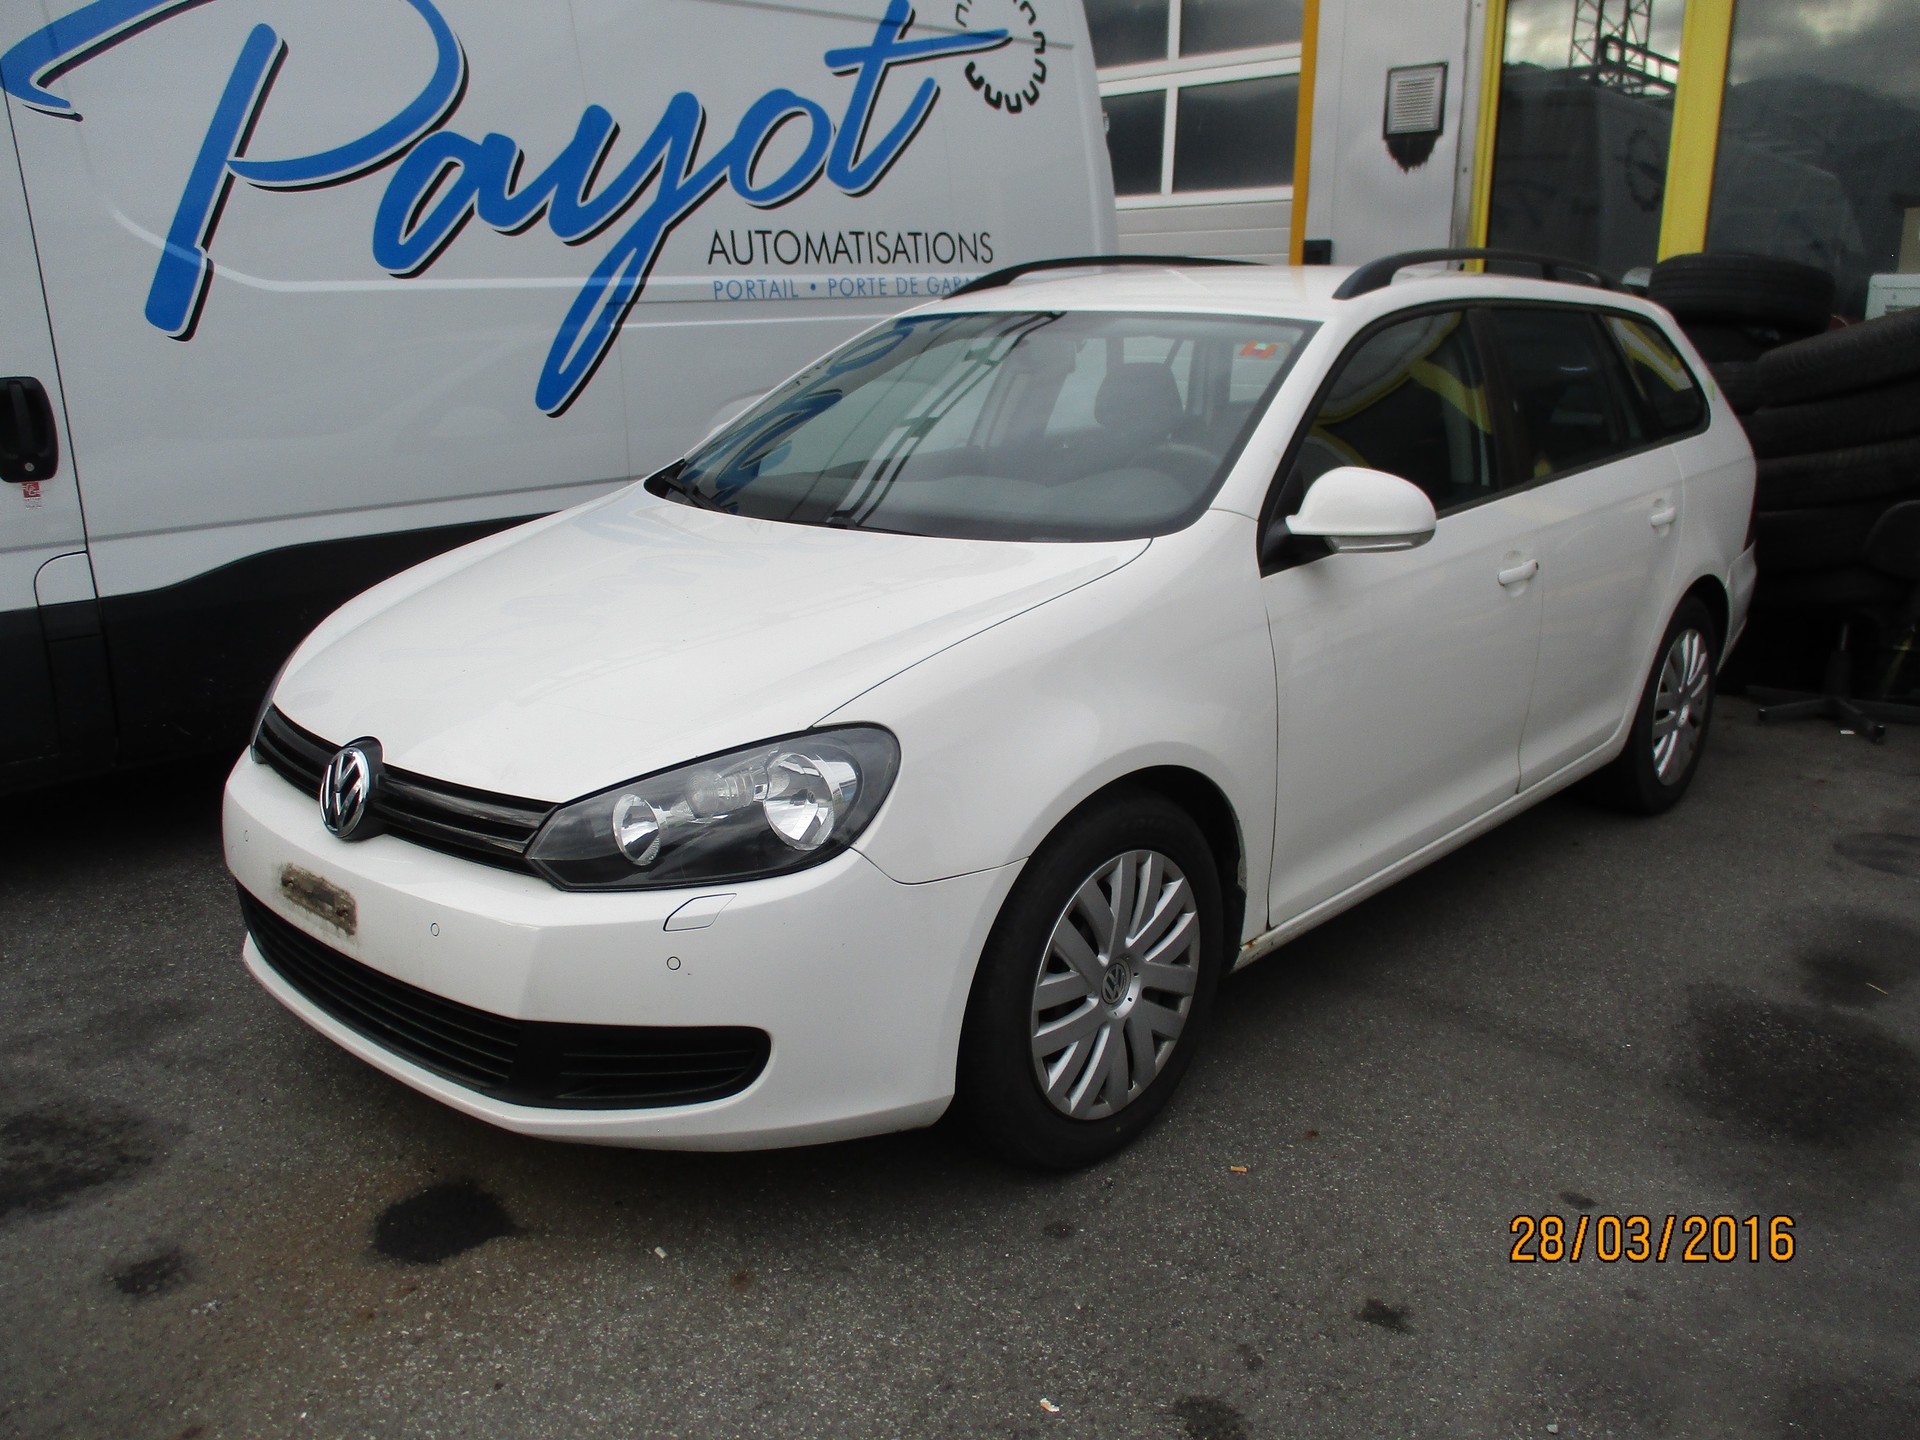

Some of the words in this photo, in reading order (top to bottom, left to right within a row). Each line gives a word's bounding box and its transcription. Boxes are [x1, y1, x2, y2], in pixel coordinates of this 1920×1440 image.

[0, 0, 1013, 417] Payot
[708, 229, 994, 265] AUTOMATISATIONS
[713, 277, 799, 300] PORTAIL
[828, 275, 888, 297] PORTE
[896, 276, 919, 296] DE
